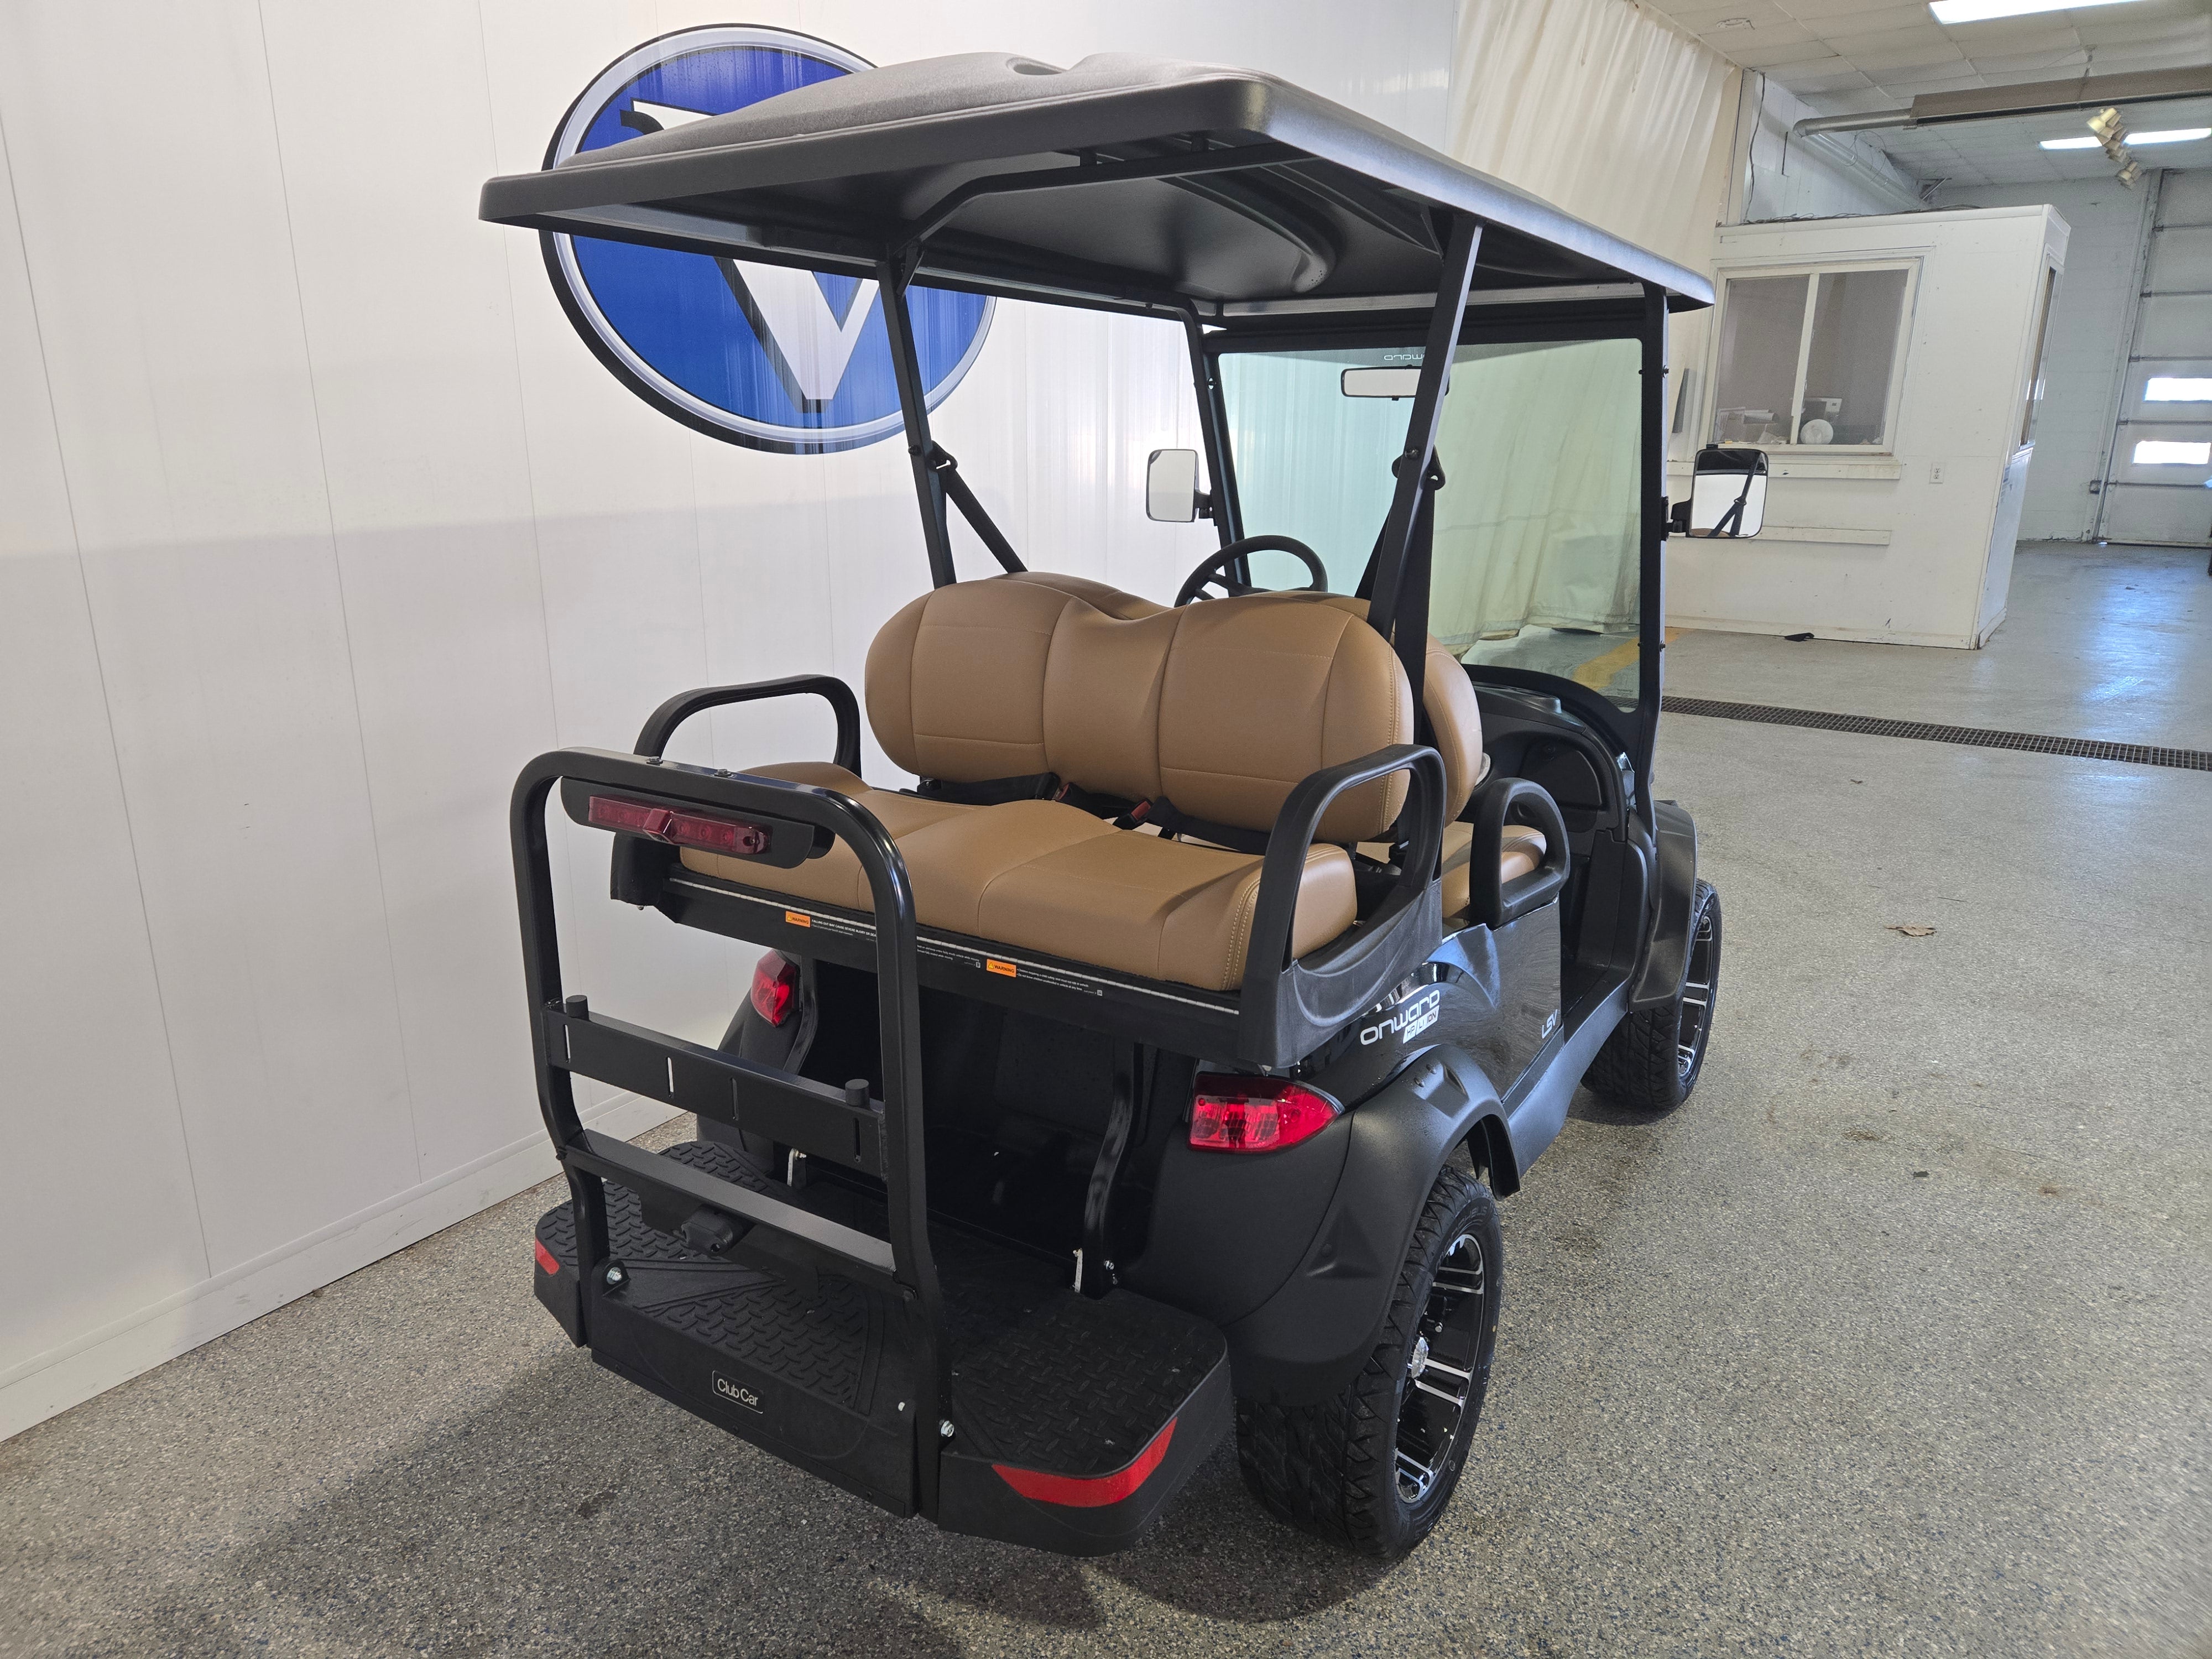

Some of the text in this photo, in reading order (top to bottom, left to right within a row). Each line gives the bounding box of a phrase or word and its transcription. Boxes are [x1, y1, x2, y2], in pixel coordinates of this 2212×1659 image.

[994, 964, 1014, 973] WARNING
[1360, 989, 1441, 1045] onward
[1407, 1025, 1415, 1037] HP
[1541, 1009, 1558, 1039] LSV
[717, 1378, 759, 1406] Club Car
